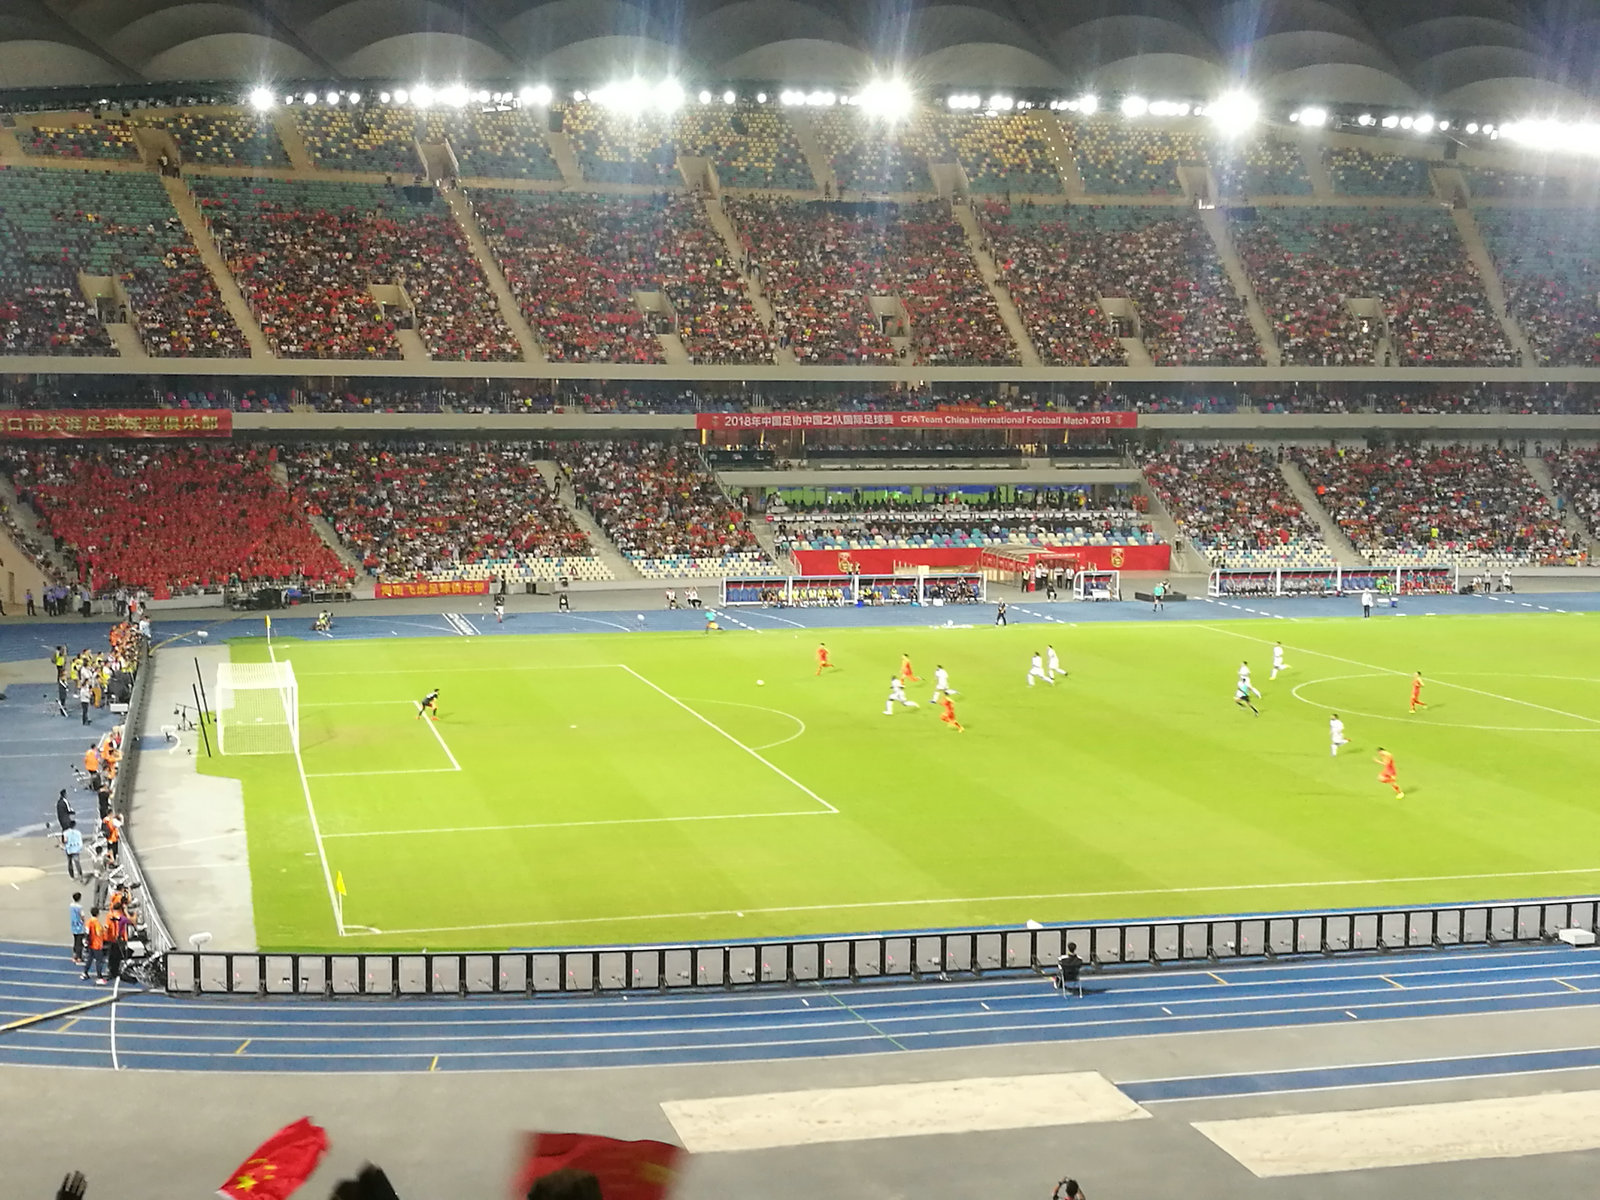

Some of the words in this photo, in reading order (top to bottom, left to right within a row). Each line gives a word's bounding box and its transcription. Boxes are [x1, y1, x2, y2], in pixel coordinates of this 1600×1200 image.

[0, 415, 219, 432] 口市天涯足球球迷俱乐部
[724, 414, 894, 427] 2018年中国足协中国之队国际足球赛
[900, 415, 919, 424] CFA
[920, 415, 943, 424] Team
[944, 415, 970, 424] China
[971, 415, 1025, 424] International
[1026, 416, 1061, 425] Football
[1062, 416, 1089, 425] Match
[1090, 416, 1111, 425] 2018
